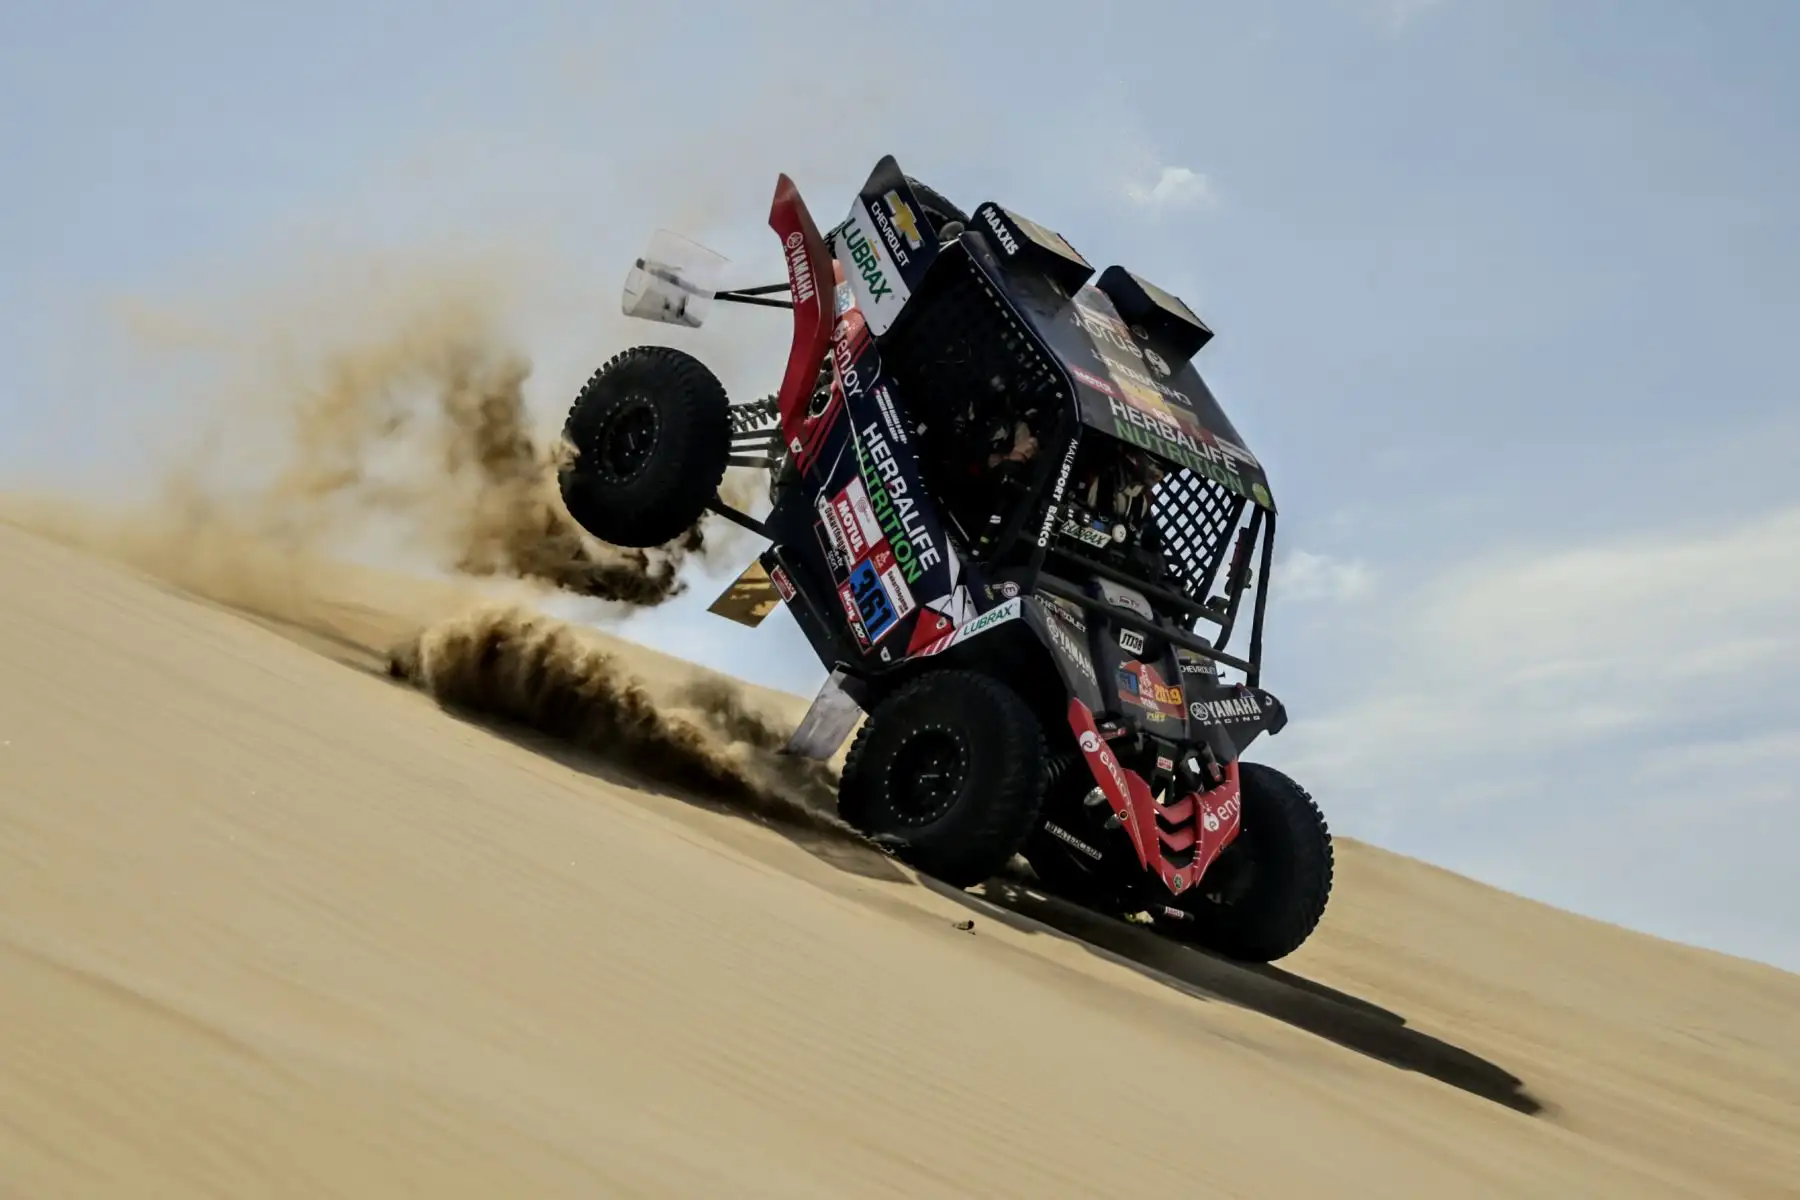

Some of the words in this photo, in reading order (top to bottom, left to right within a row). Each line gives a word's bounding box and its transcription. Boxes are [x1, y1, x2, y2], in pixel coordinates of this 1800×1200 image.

[871, 201, 910, 267] CHEVROLET
[982, 206, 1019, 256] MAXXIS
[790, 245, 814, 303] YAMAHA
[841, 217, 892, 304] LUBRAX
[1108, 396, 1239, 475] HERBALIFE
[1114, 418, 1245, 494] NUTRITION
[862, 421, 941, 571] HERBALIFE
[1053, 438, 1079, 501] MALLSPORT
[837, 500, 864, 552] MOTUL
[851, 435, 922, 584] NUTRITION
[1037, 505, 1057, 547] BANCO
[851, 568, 891, 632] 361
[963, 604, 1013, 636] LUBRAX
[1154, 684, 1182, 705] 2019
[1180, 665, 1216, 675] CHEVROLET
[1204, 715, 1260, 725] RACING
[1205, 697, 1261, 718] YAMAHA
